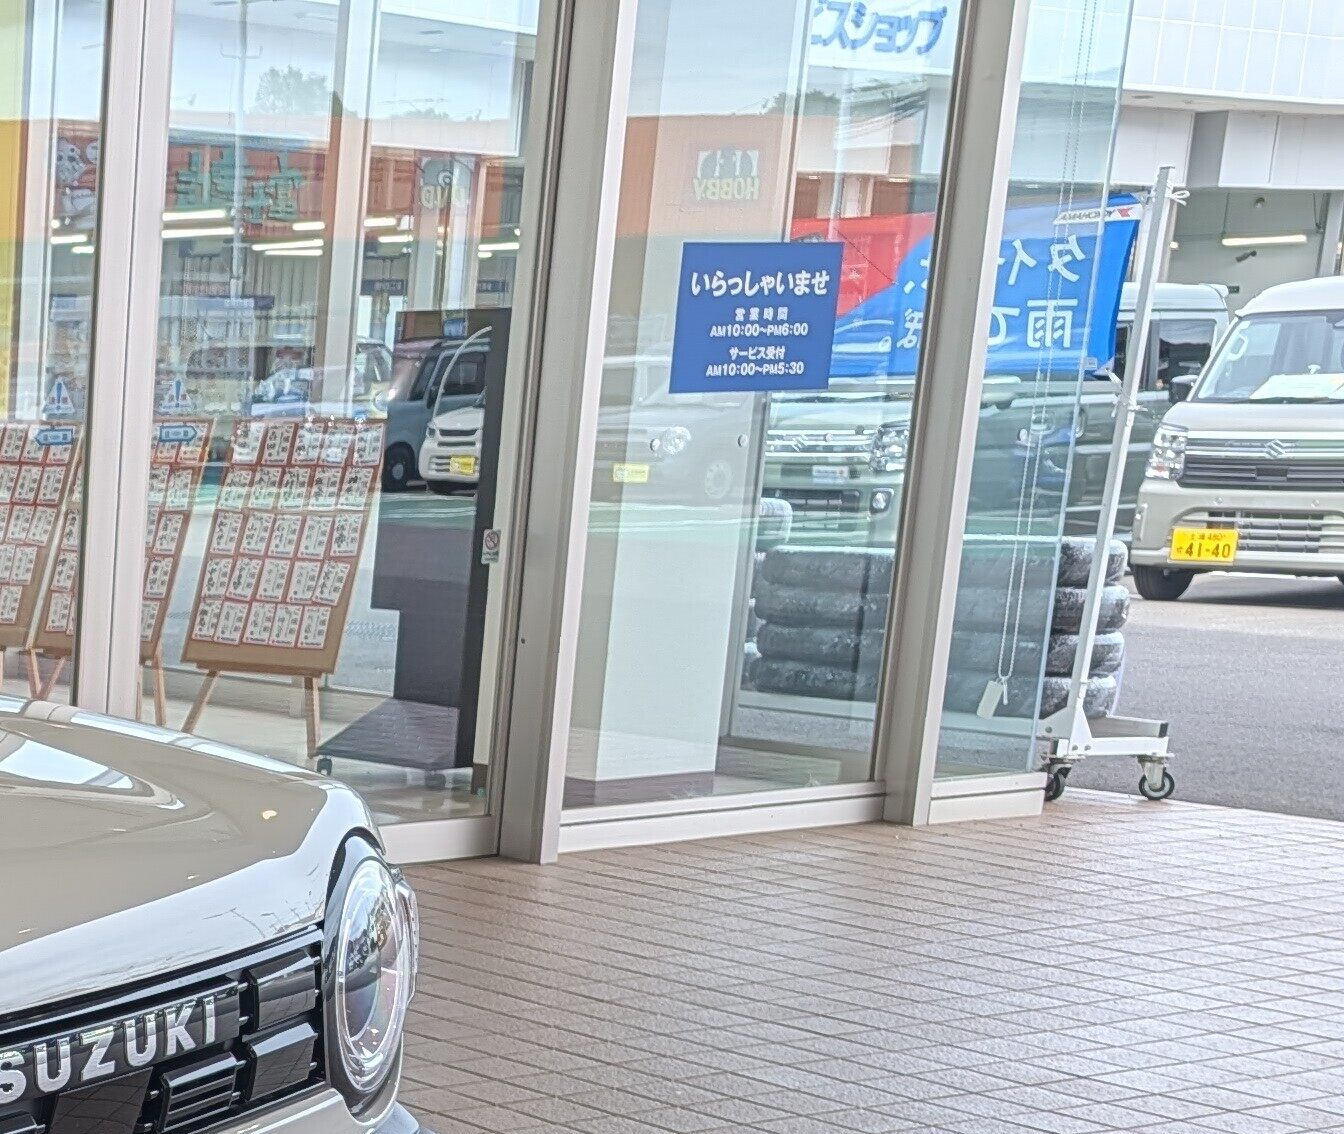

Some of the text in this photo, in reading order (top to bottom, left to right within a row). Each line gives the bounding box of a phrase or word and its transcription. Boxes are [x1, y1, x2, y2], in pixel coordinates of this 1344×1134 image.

[691, 269, 830, 297] いらっしゃいませ
[734, 306, 789, 322] 営業時間
[729, 345, 786, 360] サービス受付
[1185, 542, 1231, 558] 41-40
